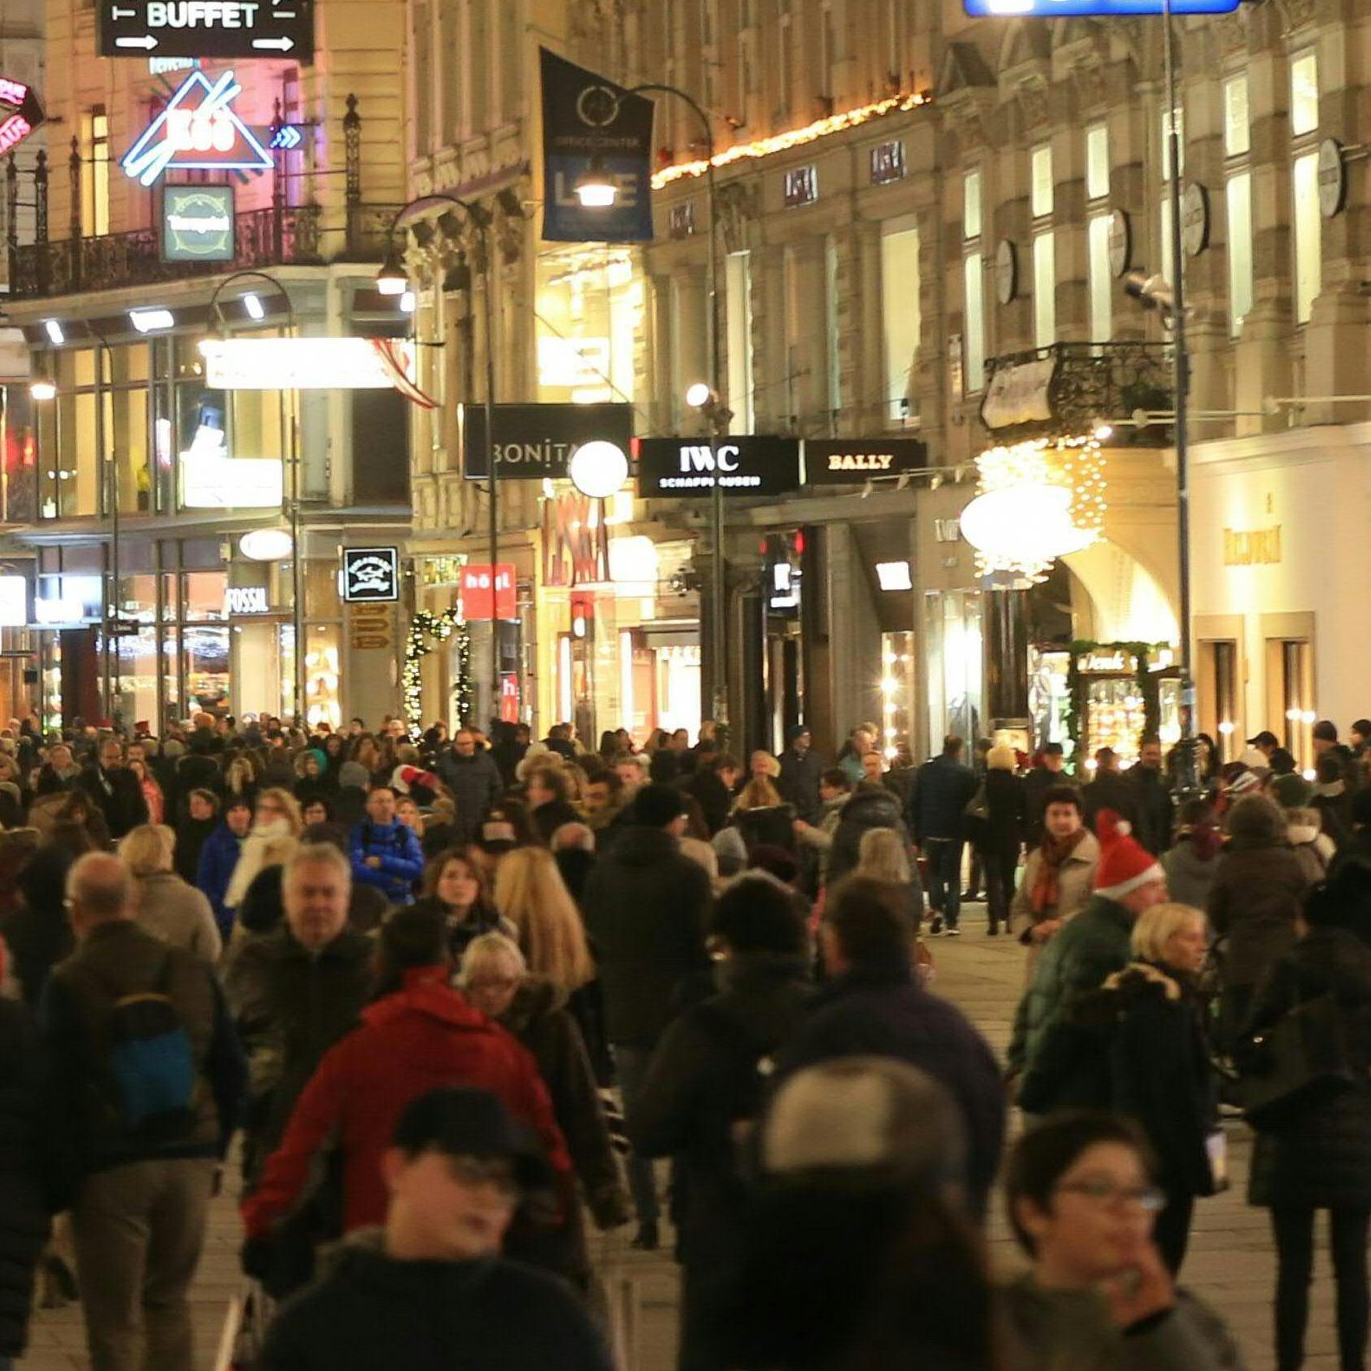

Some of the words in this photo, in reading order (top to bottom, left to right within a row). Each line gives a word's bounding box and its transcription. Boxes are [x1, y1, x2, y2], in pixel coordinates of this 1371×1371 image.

[147, 1, 259, 28] BUFFET
[680, 446, 740, 472] IWC
[828, 455, 894, 470] BALLY
[226, 588, 269, 613] FOSSIL
